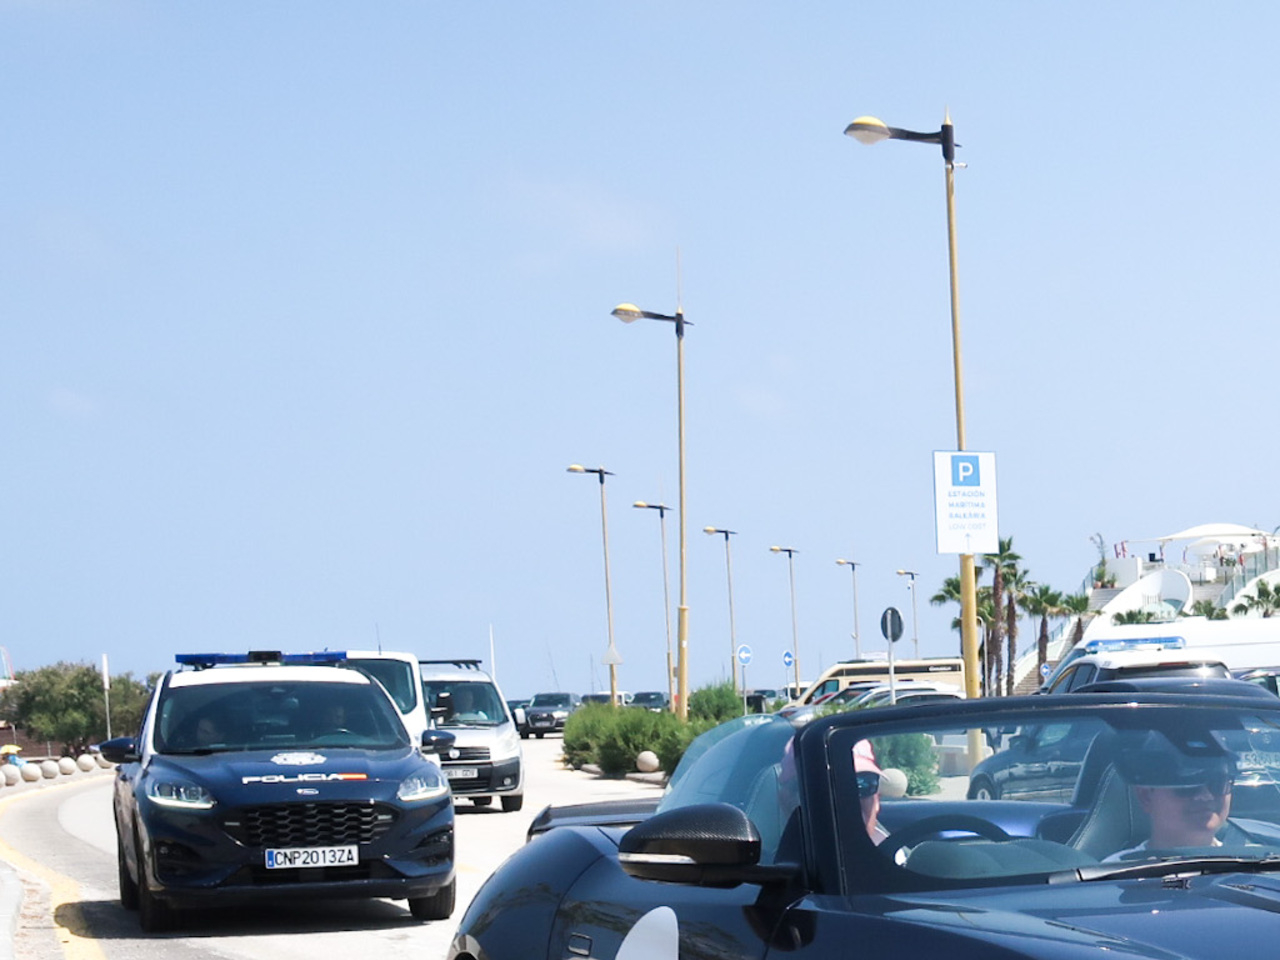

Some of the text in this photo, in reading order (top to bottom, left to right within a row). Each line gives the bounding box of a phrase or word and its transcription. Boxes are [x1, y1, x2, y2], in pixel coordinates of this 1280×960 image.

[958, 462, 974, 482] P
[242, 773, 343, 785] POLICIA
[274, 848, 354, 866] CNP2013ZA
